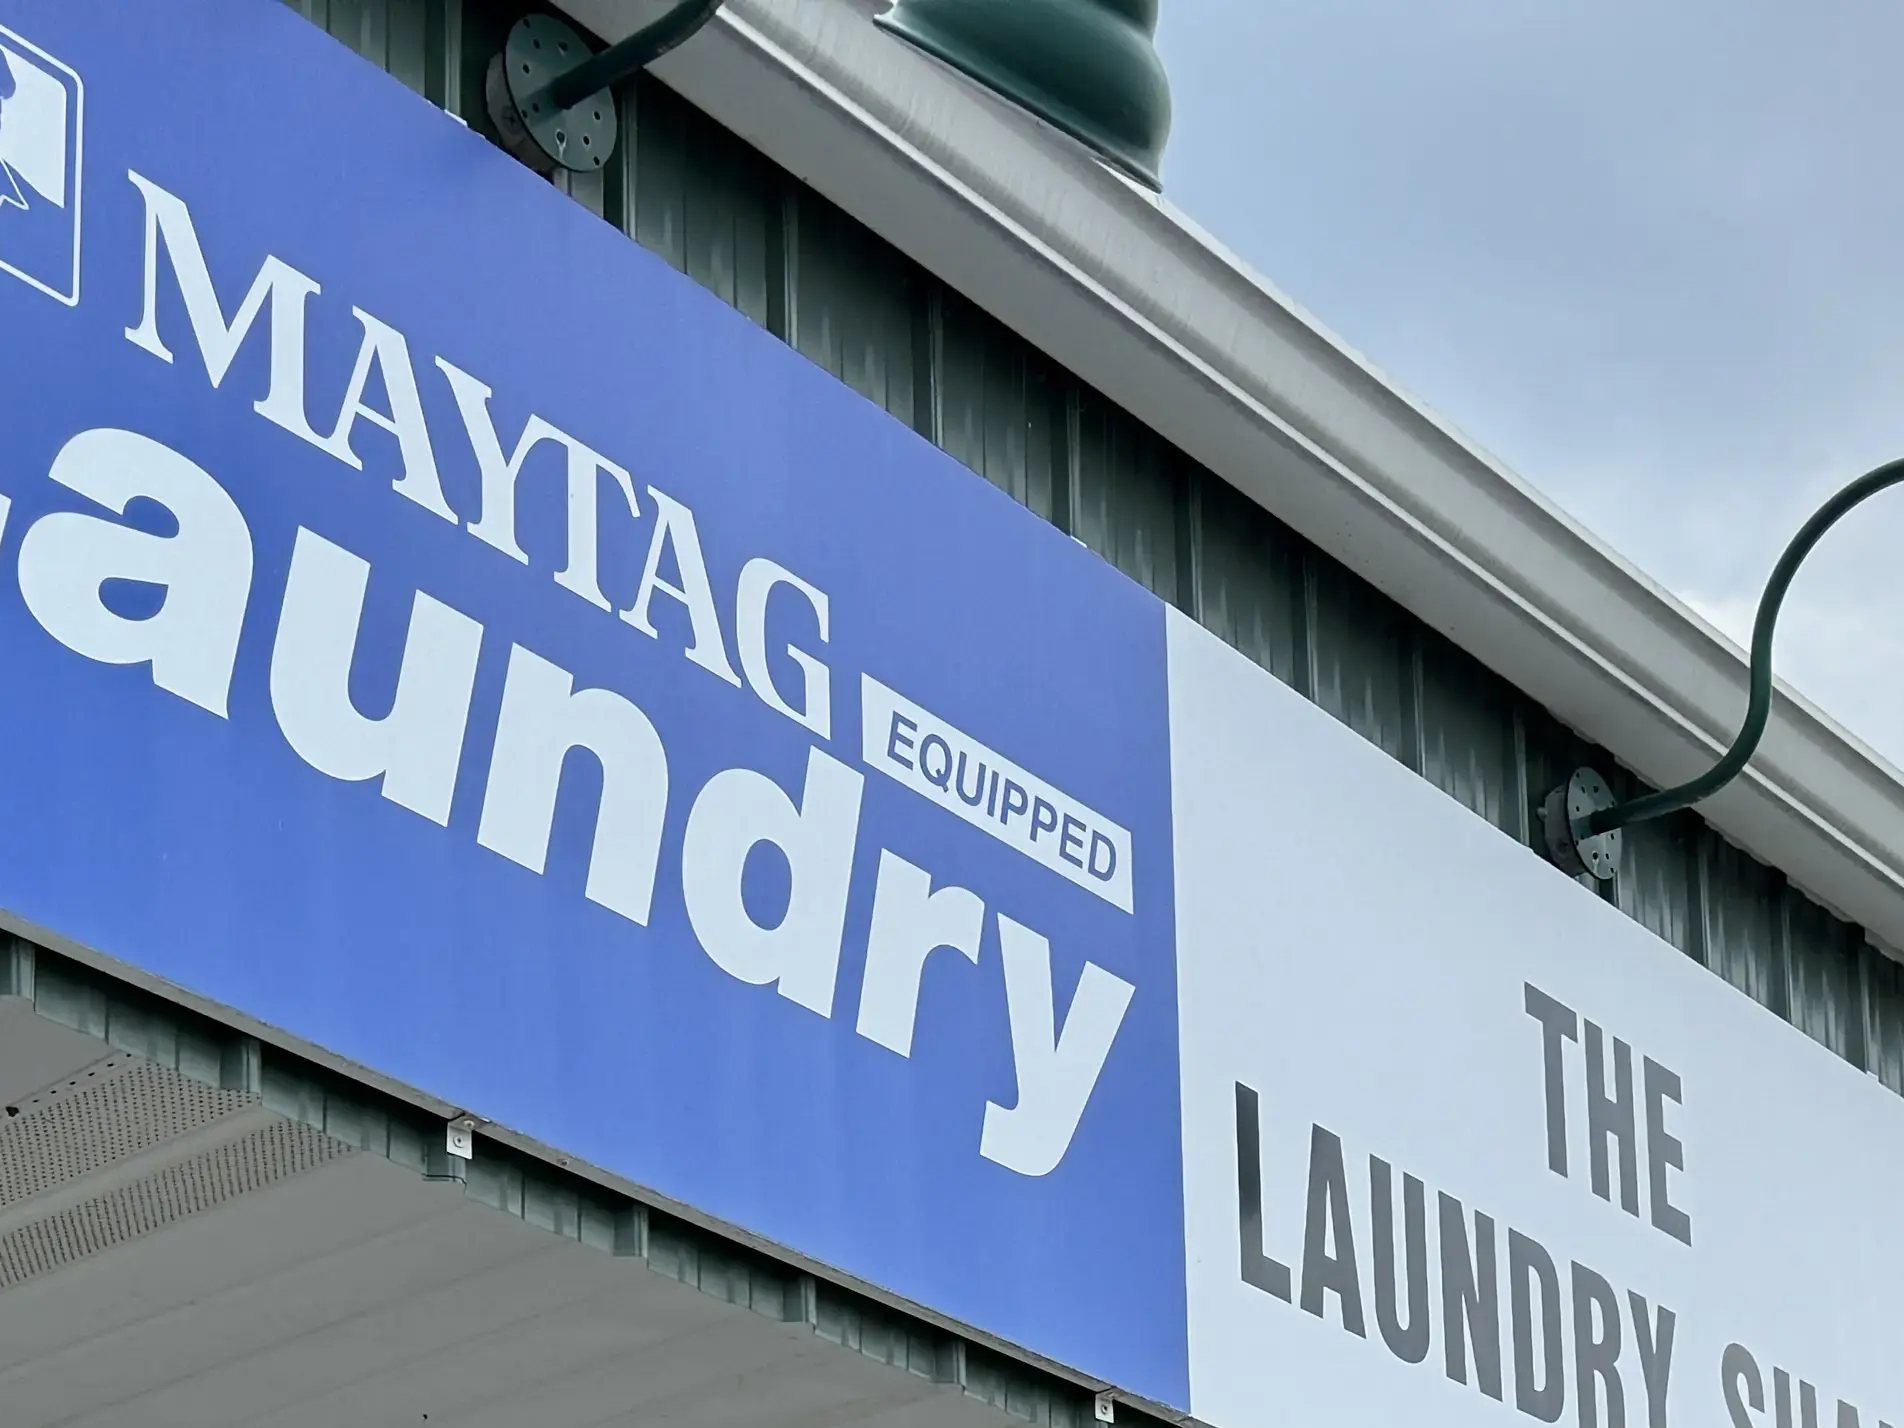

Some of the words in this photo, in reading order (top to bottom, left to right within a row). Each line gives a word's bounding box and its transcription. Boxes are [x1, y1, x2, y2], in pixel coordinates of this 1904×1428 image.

[125, 168, 832, 740] MAYTAG
[886, 714, 1118, 884] EQUIPPED
[1524, 981, 1692, 1247] THE
